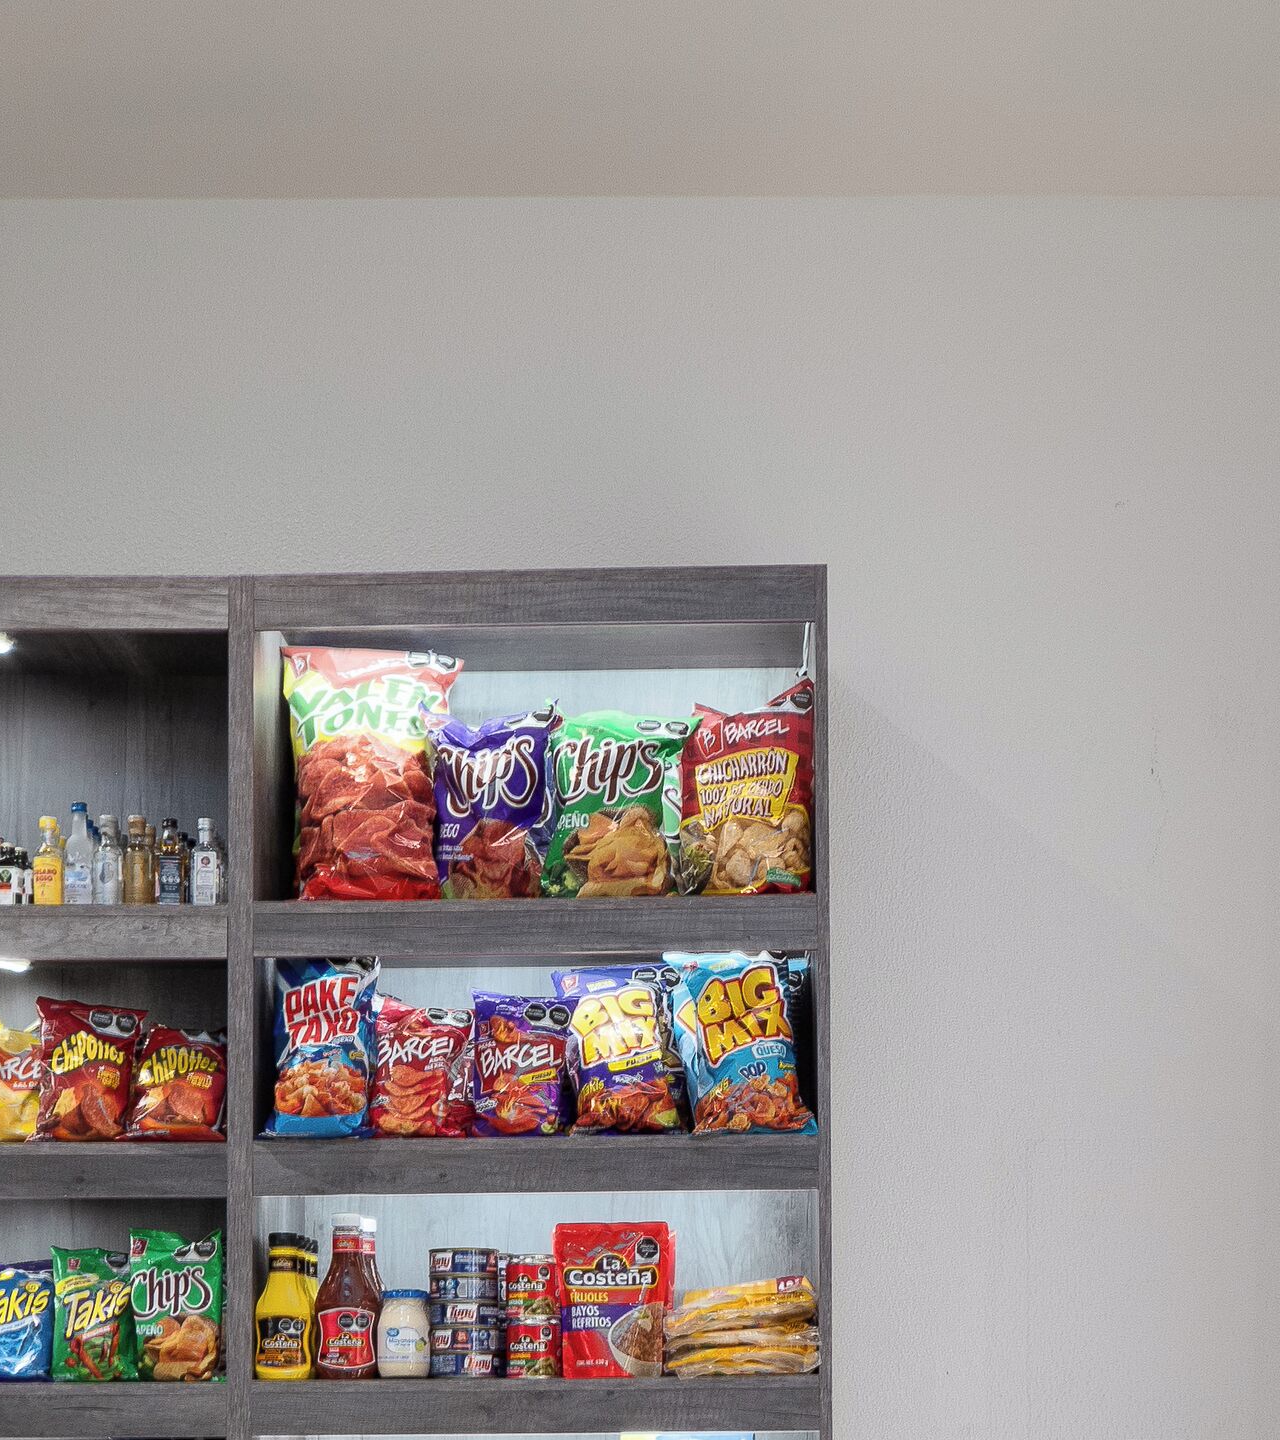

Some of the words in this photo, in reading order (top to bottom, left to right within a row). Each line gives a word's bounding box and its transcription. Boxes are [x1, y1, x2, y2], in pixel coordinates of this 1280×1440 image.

[724, 718, 791, 744] BARCEL
[553, 736, 662, 805] Chip's
[440, 822, 460, 838] EGO
[558, 810, 590, 830] PEÑO
[284, 976, 359, 1023] PAKE
[696, 967, 780, 1025] BIG
[287, 1008, 360, 1048] TAXO
[571, 989, 656, 1037] BIG
[582, 1015, 657, 1065] MIX
[705, 1003, 791, 1064] MIX
[481, 1041, 563, 1079] BARCEL
[755, 1044, 786, 1057] QUESO
[740, 1062, 767, 1081] POP
[569, 1268, 653, 1286] Costeña
[602, 1257, 621, 1270] La
[129, 1265, 212, 1320] Chip's
[570, 1291, 609, 1303] FRIJOLES
[63, 1282, 132, 1340] Takis
[571, 1305, 600, 1317] BAYOS
[571, 1316, 612, 1329] REFRITOS
